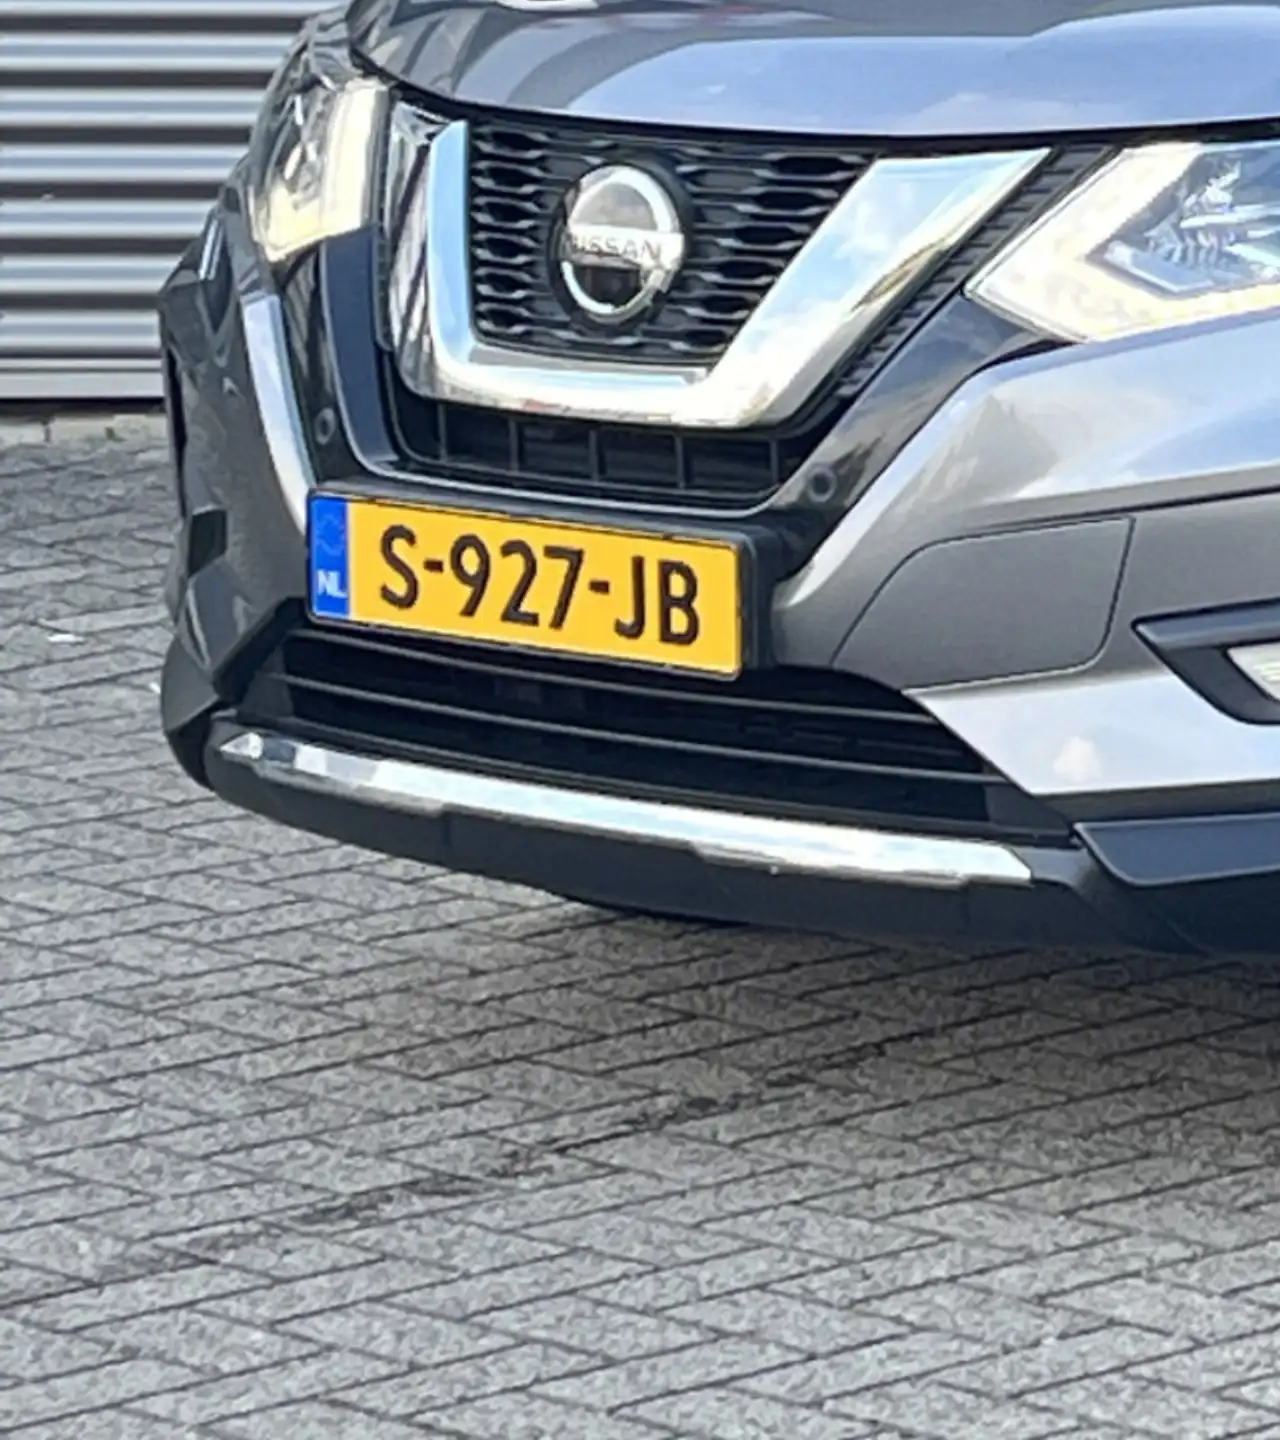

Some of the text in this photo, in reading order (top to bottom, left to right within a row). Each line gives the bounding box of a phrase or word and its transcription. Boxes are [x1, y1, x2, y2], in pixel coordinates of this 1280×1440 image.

[568, 232, 662, 260] NISSAN
[317, 570, 346, 600] NL
[380, 523, 700, 646] S-927-JB
